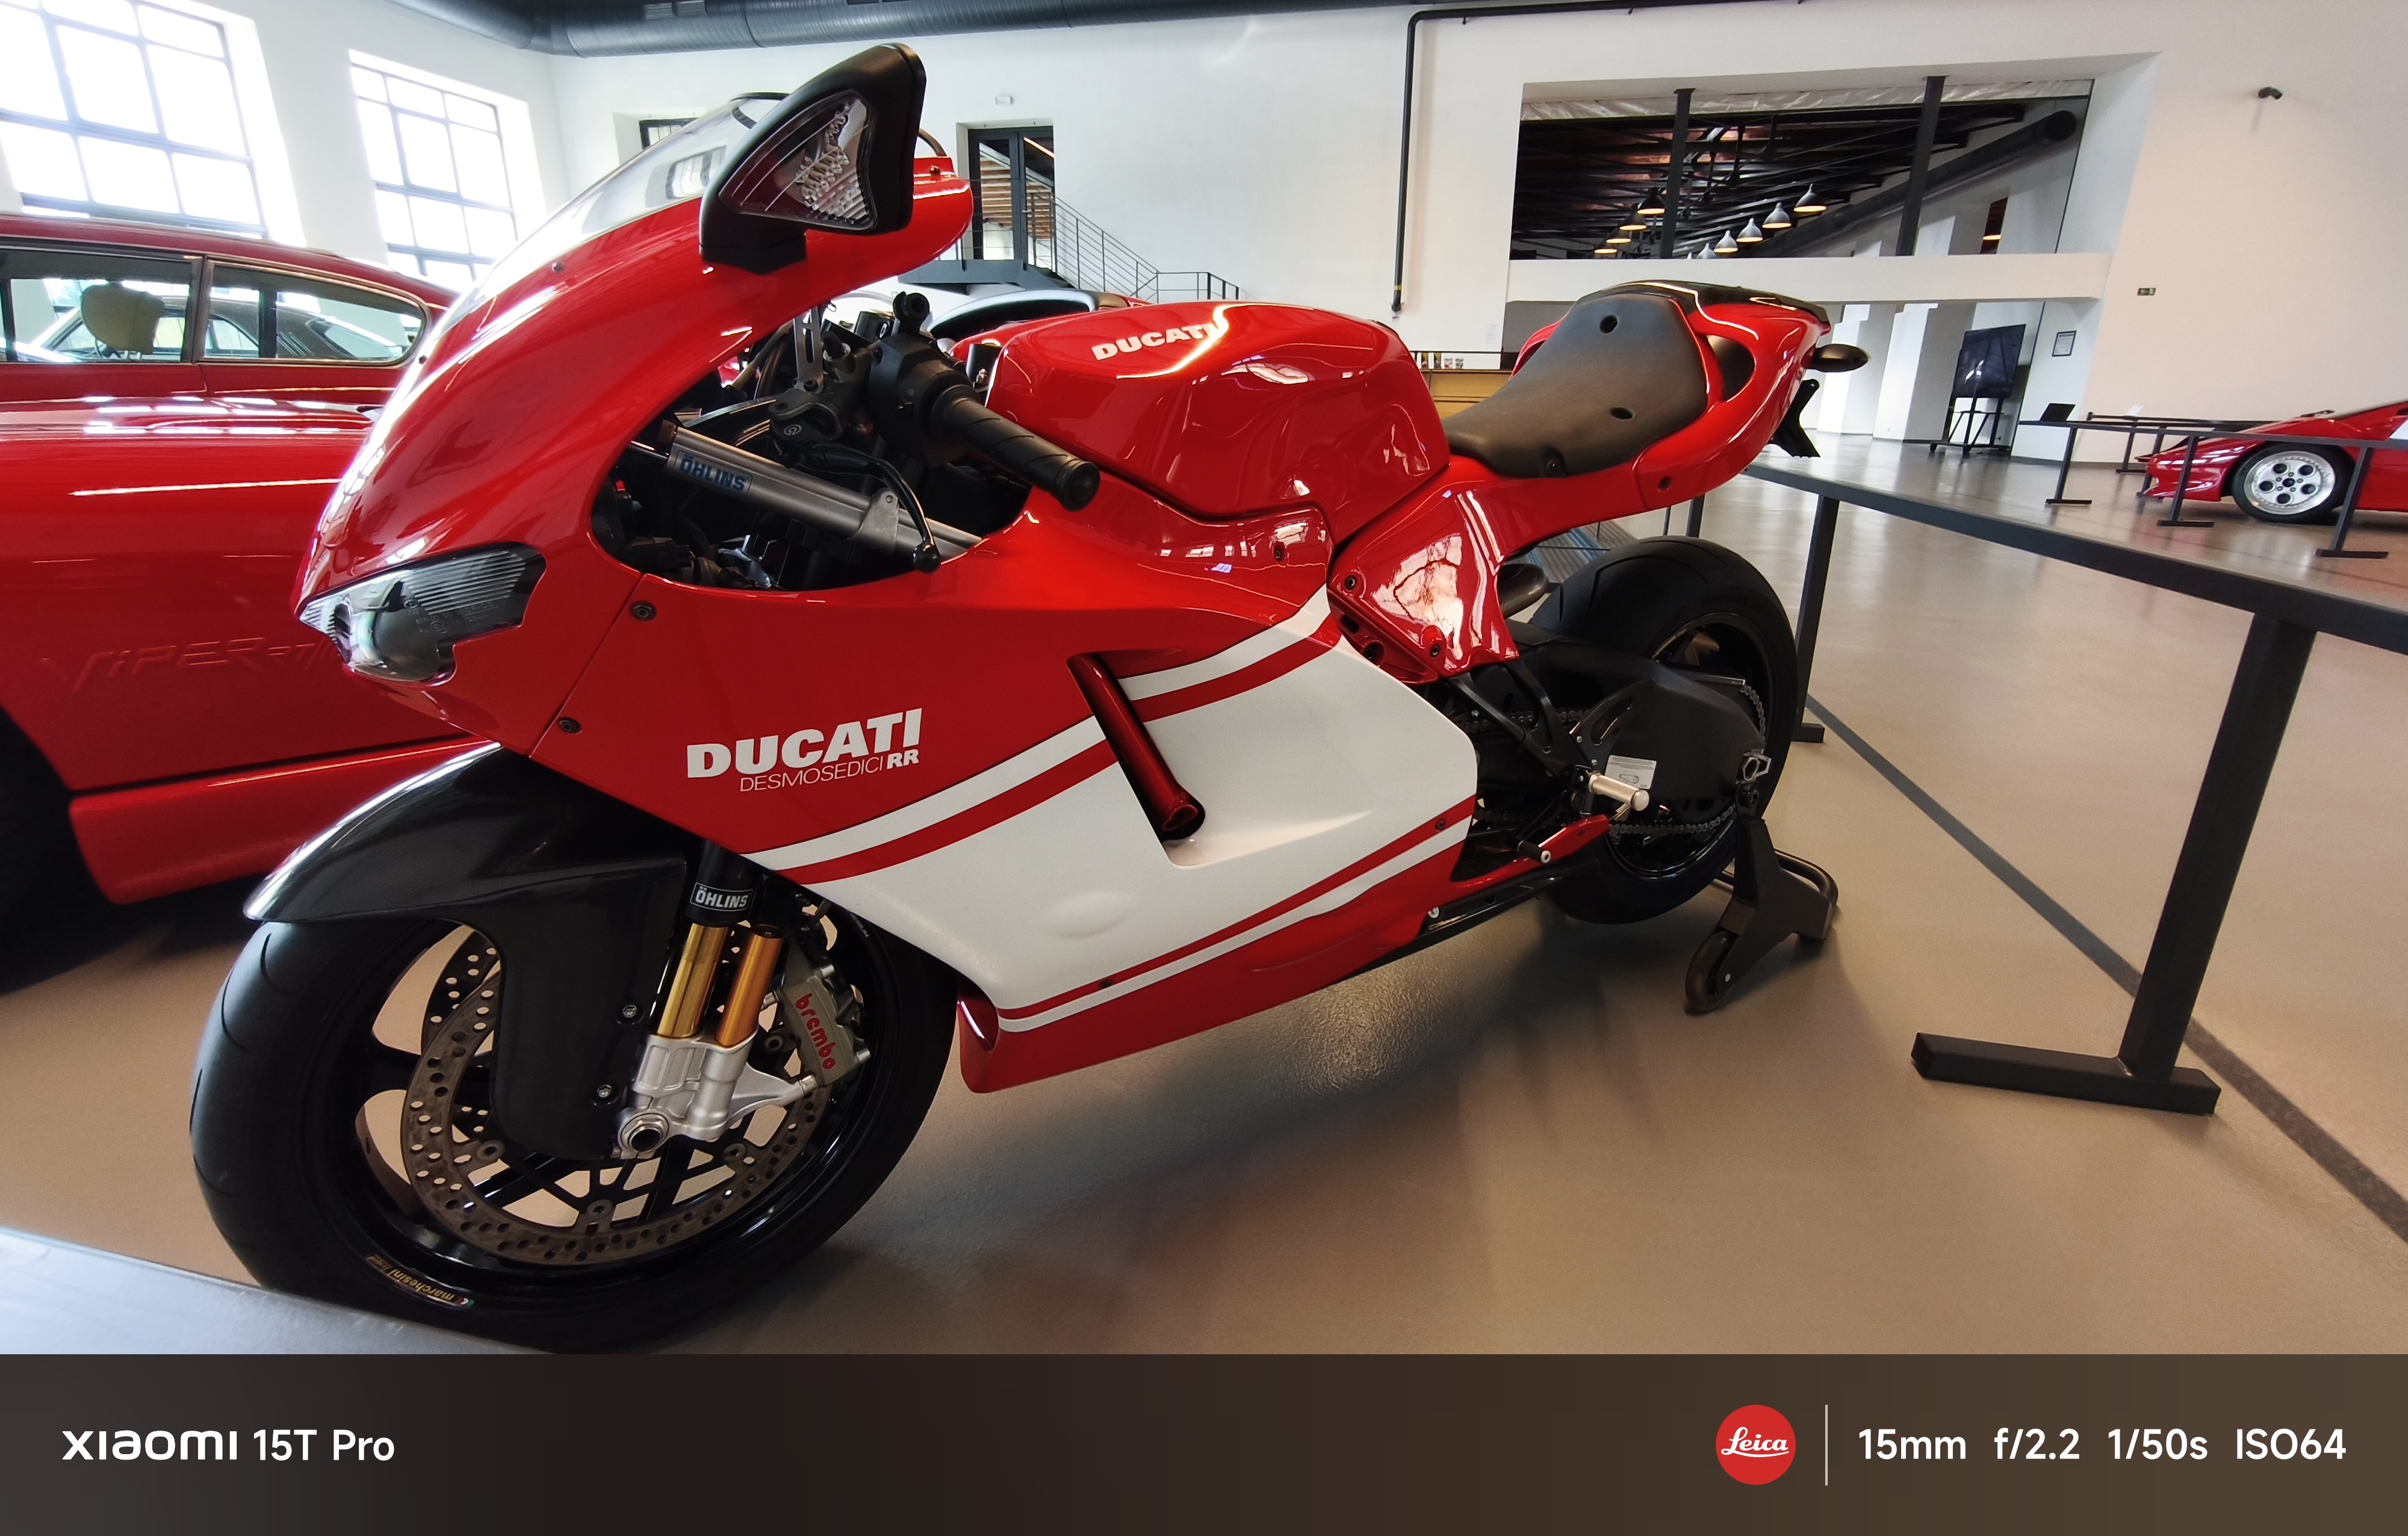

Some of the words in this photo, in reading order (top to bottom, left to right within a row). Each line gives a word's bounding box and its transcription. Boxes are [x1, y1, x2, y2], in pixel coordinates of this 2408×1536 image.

[1091, 323, 1220, 361] DUCATI
[680, 453, 746, 491] ÖHLINS
[42, 637, 266, 692] VIPER
[686, 708, 922, 778] DUCATI
[740, 756, 883, 792] DESMOSEDICI
[887, 749, 919, 770] RR
[695, 886, 749, 909] ÖHLINS
[795, 993, 836, 1070] brembo
